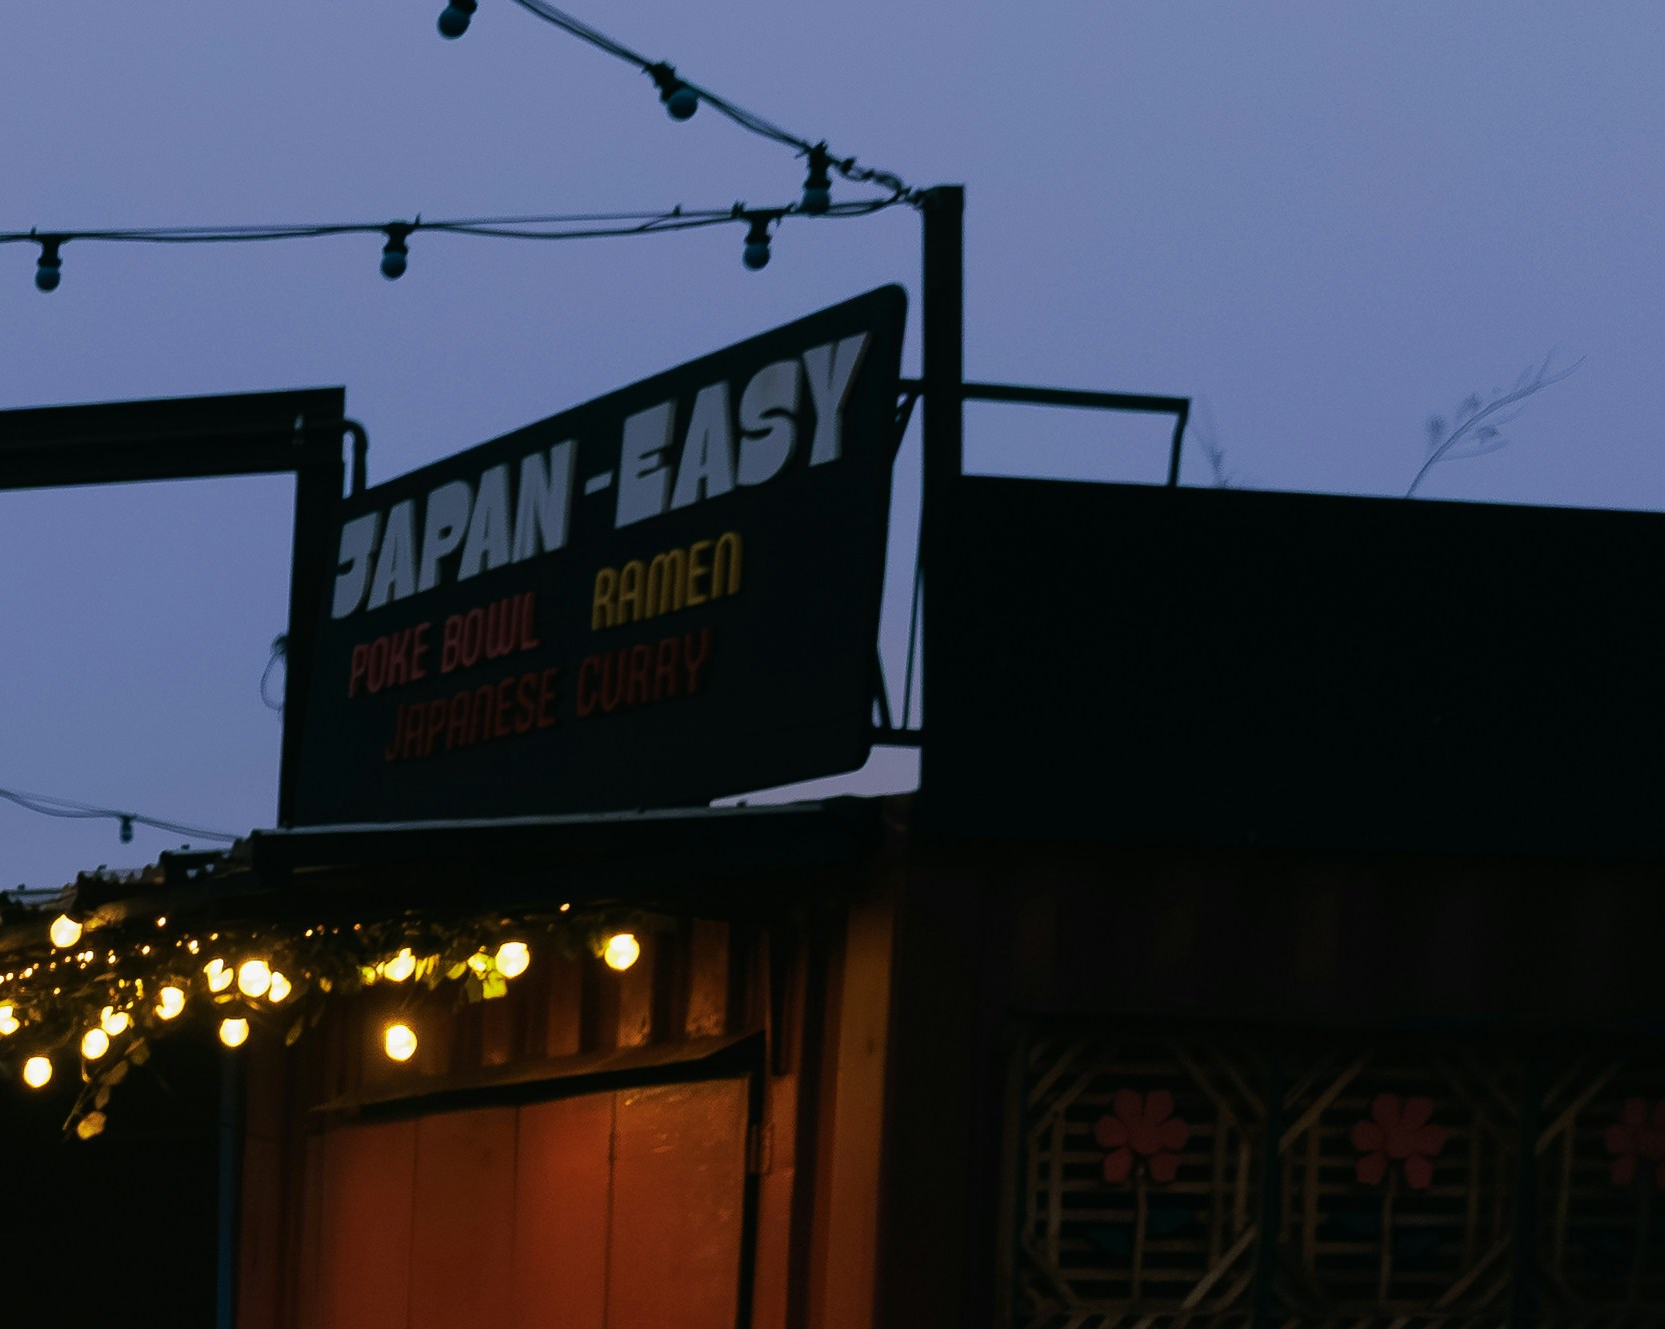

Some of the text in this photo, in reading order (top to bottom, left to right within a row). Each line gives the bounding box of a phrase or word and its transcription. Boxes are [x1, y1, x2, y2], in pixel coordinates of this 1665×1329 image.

[330, 331, 871, 619] JAPAN-EASY
[590, 530, 744, 632] RAMEN
[347, 592, 542, 699] POKE BOWL
[384, 627, 714, 763] JAPANESE CURRY
